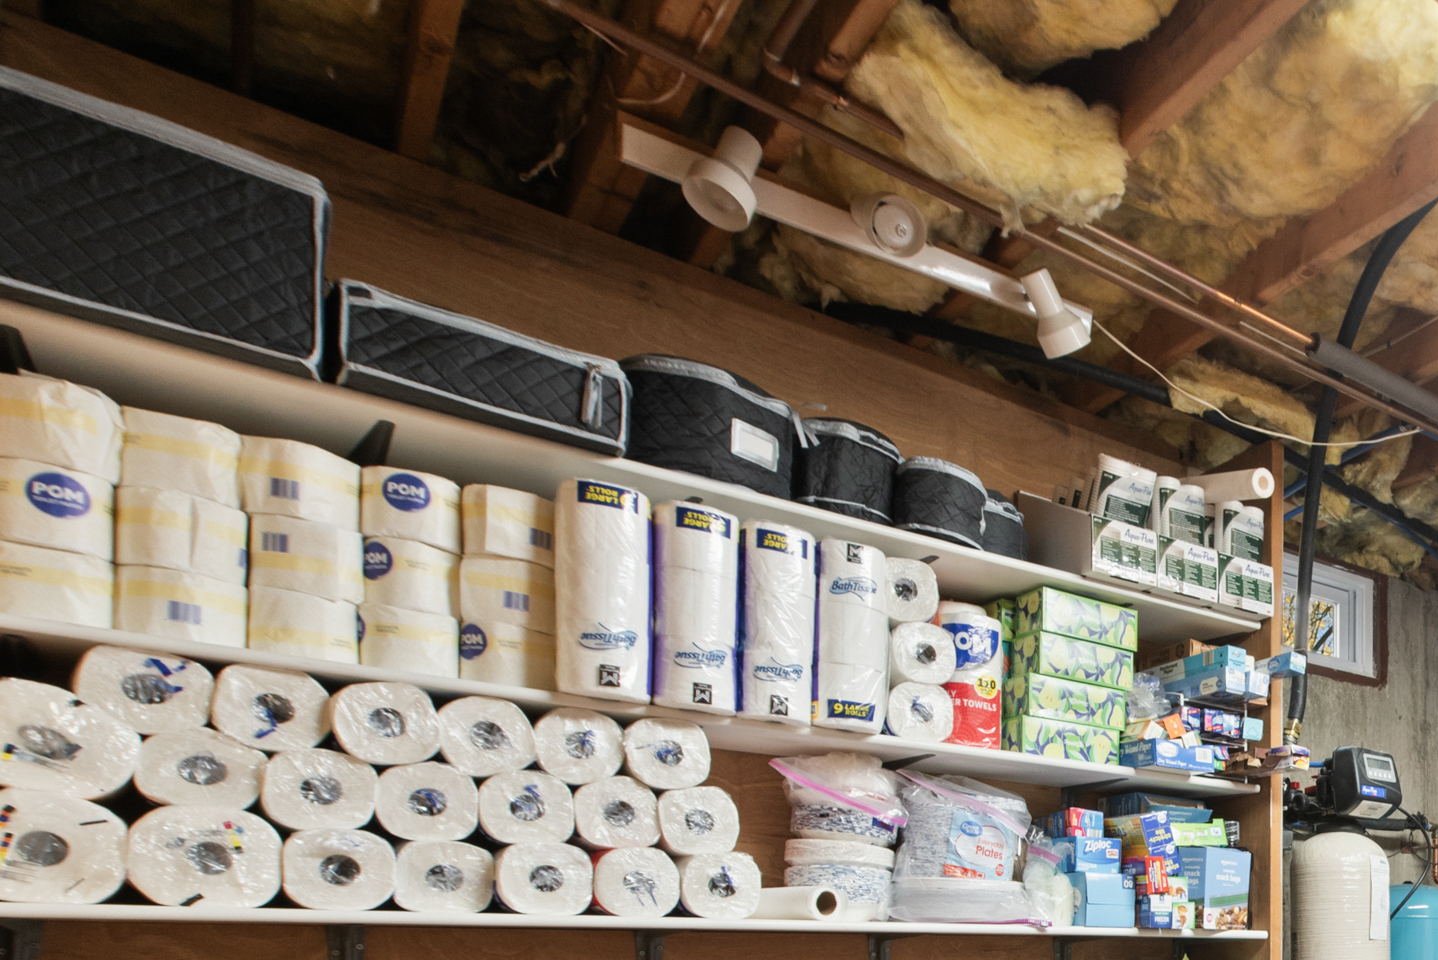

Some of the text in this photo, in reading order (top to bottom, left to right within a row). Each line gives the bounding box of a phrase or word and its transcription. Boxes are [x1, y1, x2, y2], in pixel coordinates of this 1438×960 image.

[32, 481, 84, 504] POM
[386, 481, 425, 499] POM
[588, 485, 618, 496] ROLLS
[585, 492, 618, 505] LARGE
[767, 533, 787, 543] OLLS
[1124, 528, 1154, 545] Aqua-Pure
[763, 539, 787, 550] ARGE
[1188, 547, 1215, 563] Aqua-Pure
[1245, 563, 1270, 578] Aqua-Pure
[955, 631, 992, 656] OM
[833, 702, 843, 714] 9
[962, 698, 997, 711] TOWELS
[977, 837, 1004, 850] Everyday
[1085, 839, 1112, 853] Ziploc
[975, 845, 1003, 860] Plates
[1216, 873, 1241, 884] snack bags
